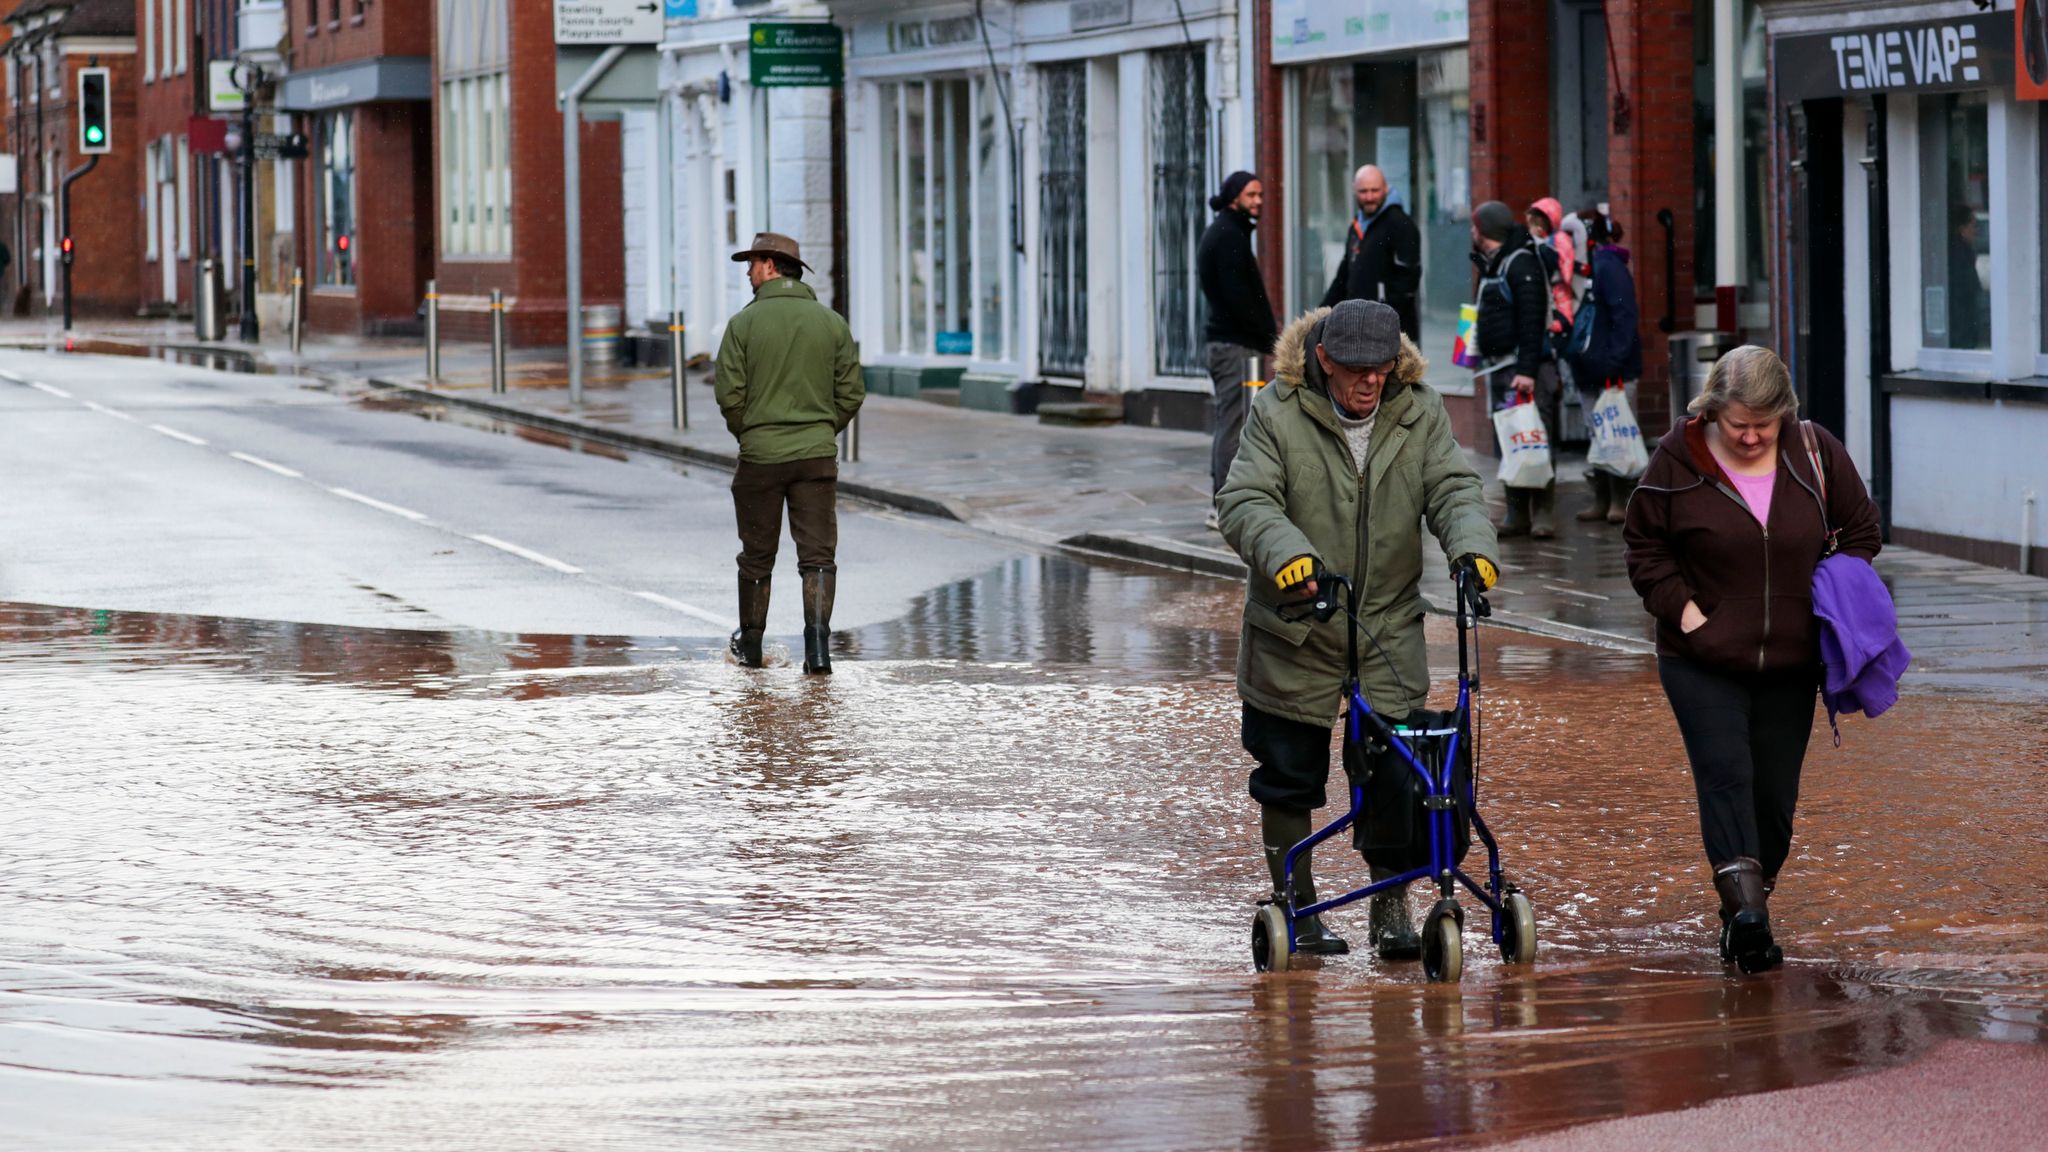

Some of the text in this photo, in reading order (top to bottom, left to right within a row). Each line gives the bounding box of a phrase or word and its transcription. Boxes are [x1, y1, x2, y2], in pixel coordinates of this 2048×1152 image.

[559, 5, 603, 15] Bowling
[560, 16, 634, 25] Tennis courts
[560, 28, 623, 38] Playground
[1831, 24, 1980, 89] TEME VAPE
